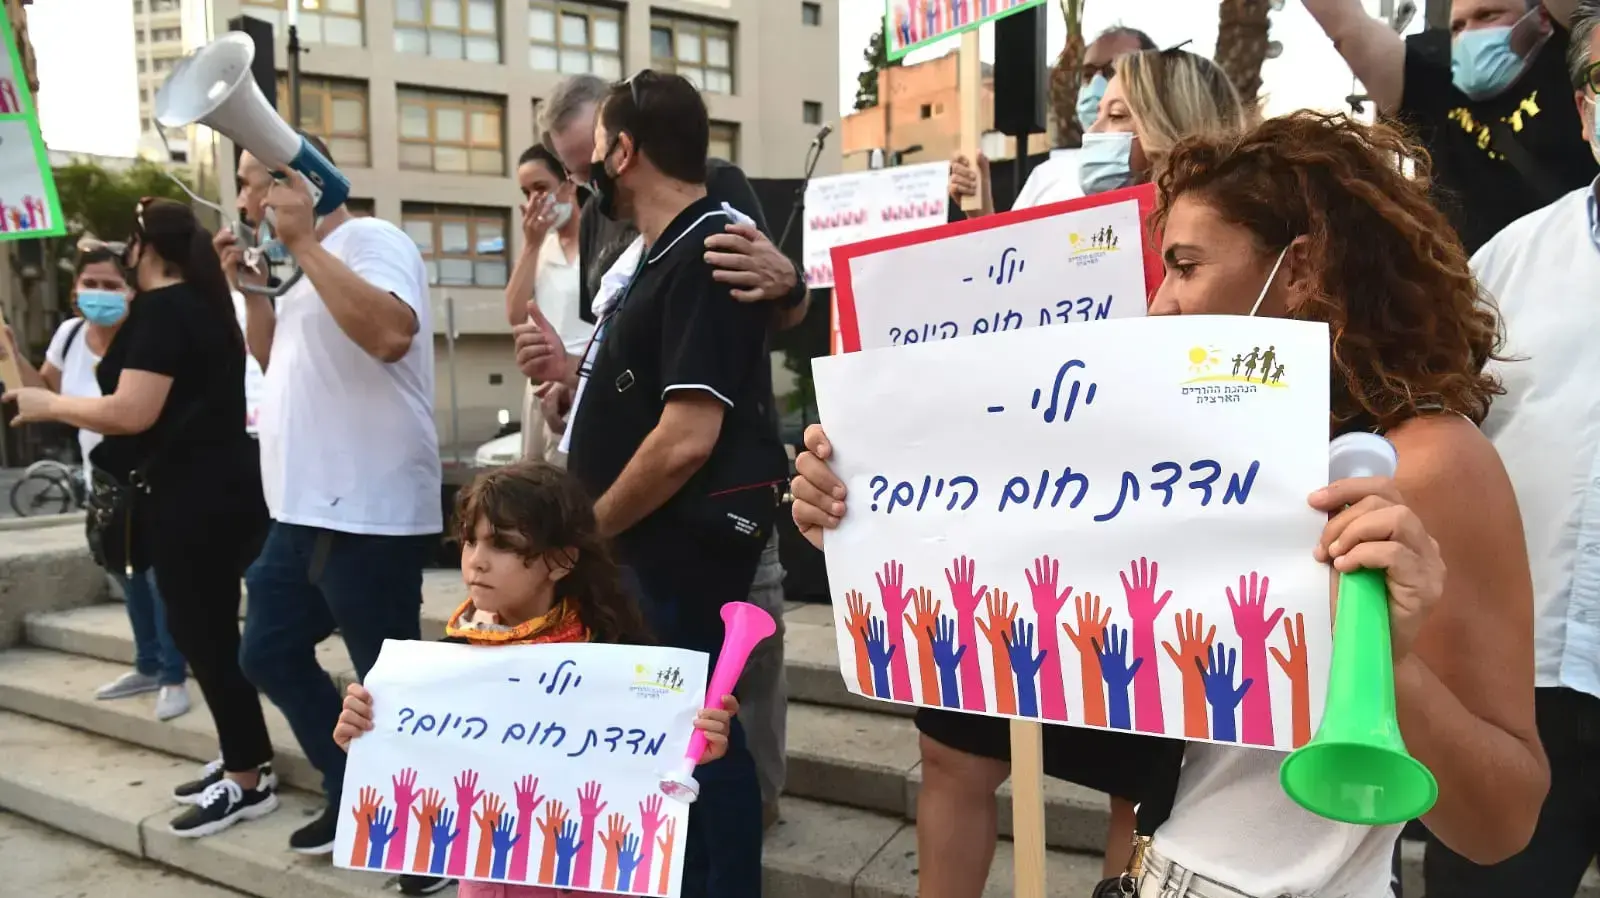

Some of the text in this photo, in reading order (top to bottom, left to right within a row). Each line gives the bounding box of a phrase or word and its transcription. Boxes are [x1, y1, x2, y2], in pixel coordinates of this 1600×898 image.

[988, 247, 1025, 285] יולי
[1030, 358, 1098, 424] יולי
[1181, 386, 1221, 396] ההורים
[1196, 394, 1241, 404] הארצית
[868, 459, 1261, 523] מדדת חום היום?
[537, 659, 583, 696] יולי
[396, 707, 668, 758] מדדת חום היום?
